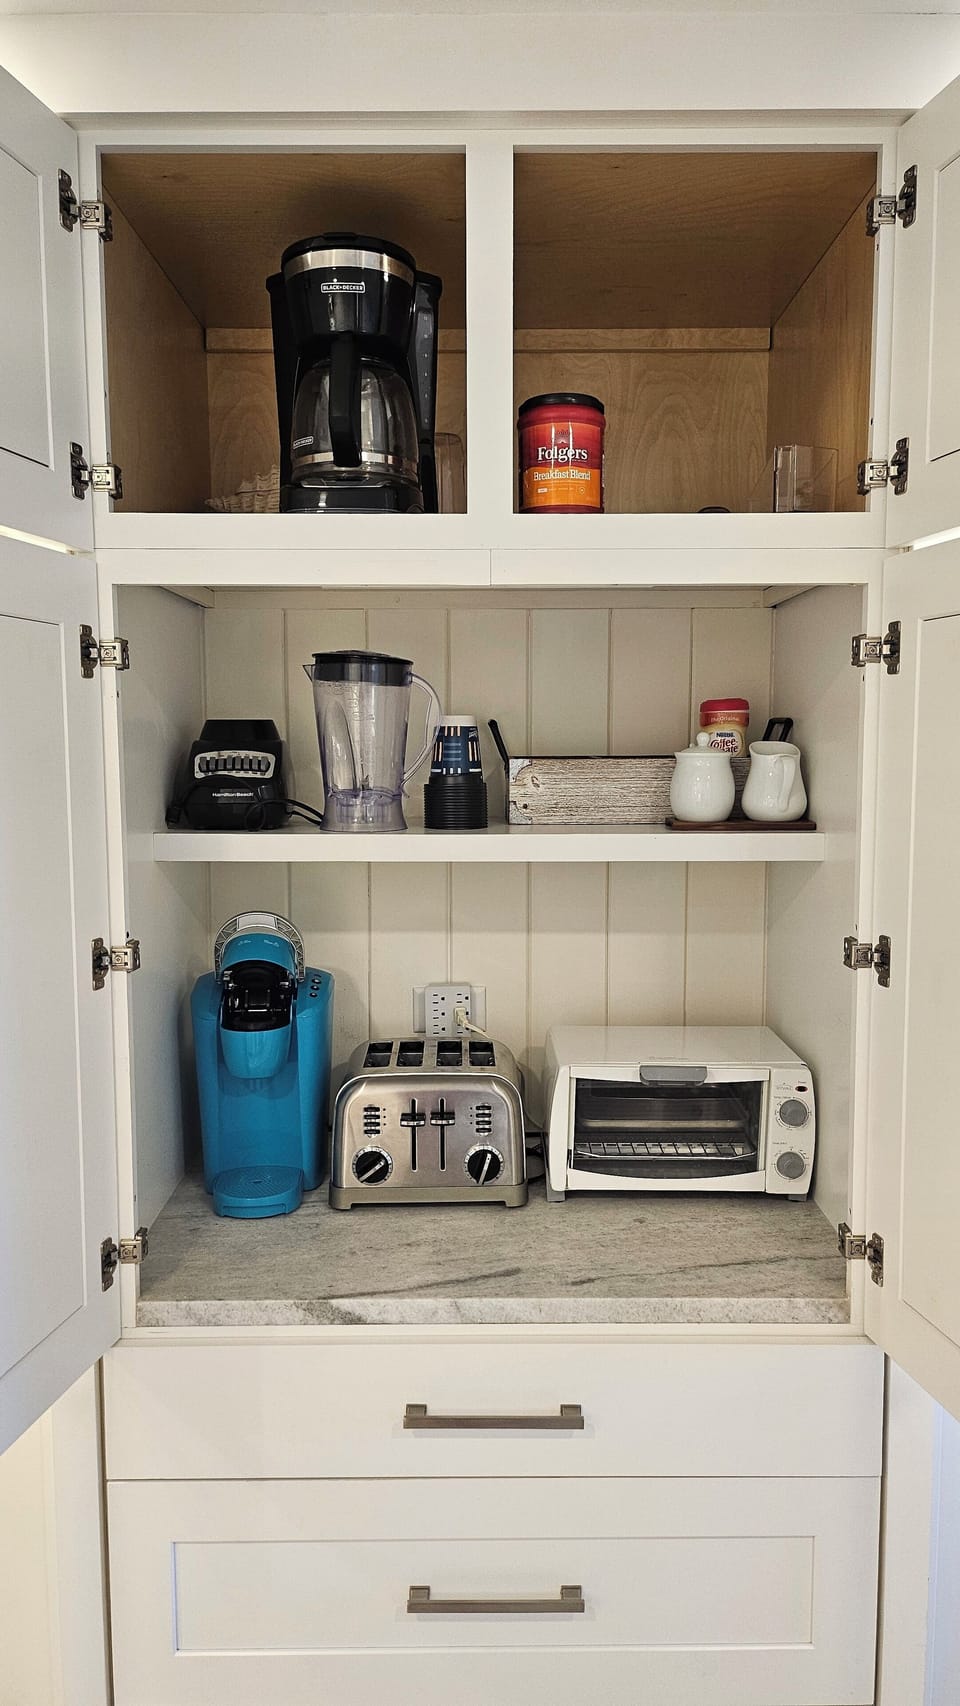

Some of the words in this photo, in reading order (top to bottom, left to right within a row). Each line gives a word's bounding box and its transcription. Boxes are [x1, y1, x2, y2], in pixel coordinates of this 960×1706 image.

[537, 445, 588, 462] Folgers
[533, 468, 569, 481] Breakfast
[570, 469, 591, 481] Blend
